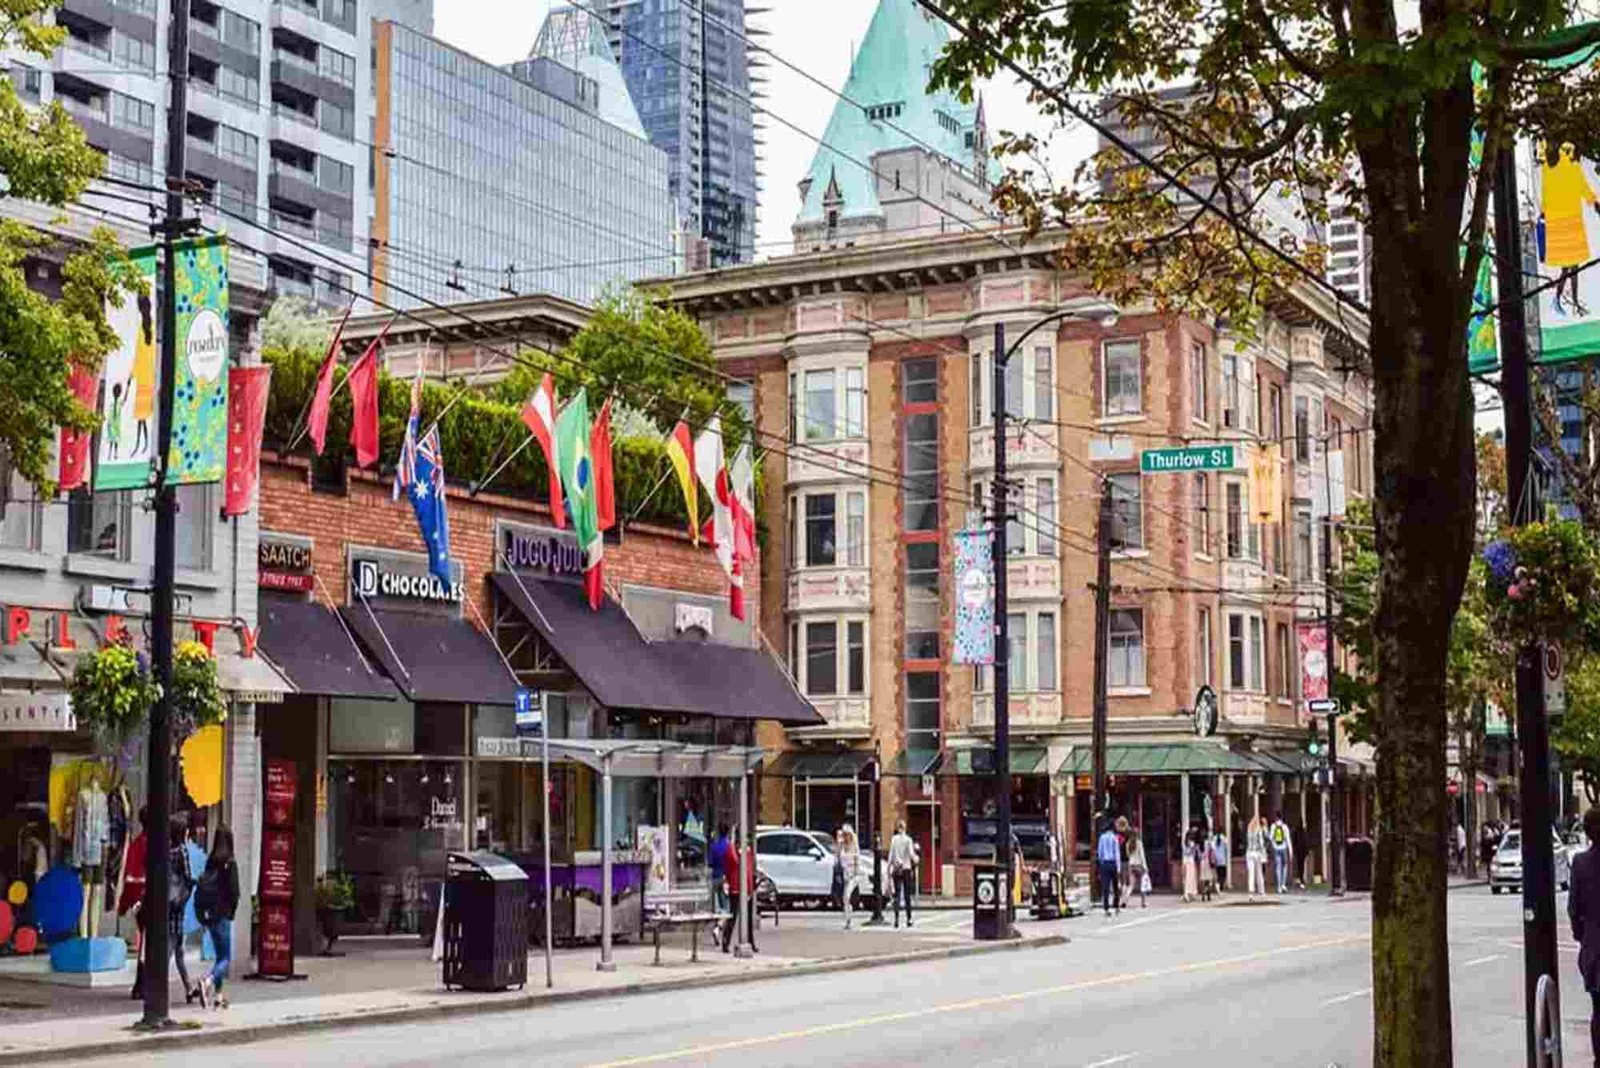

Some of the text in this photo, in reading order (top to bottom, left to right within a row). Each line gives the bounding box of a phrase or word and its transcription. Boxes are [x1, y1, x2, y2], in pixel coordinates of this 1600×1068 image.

[1147, 449, 1227, 468] Thurlow St
[508, 536, 586, 573] JUGO JUIC
[382, 572, 465, 601] CHOCOLAES
[8, 607, 260, 658] PLETY
